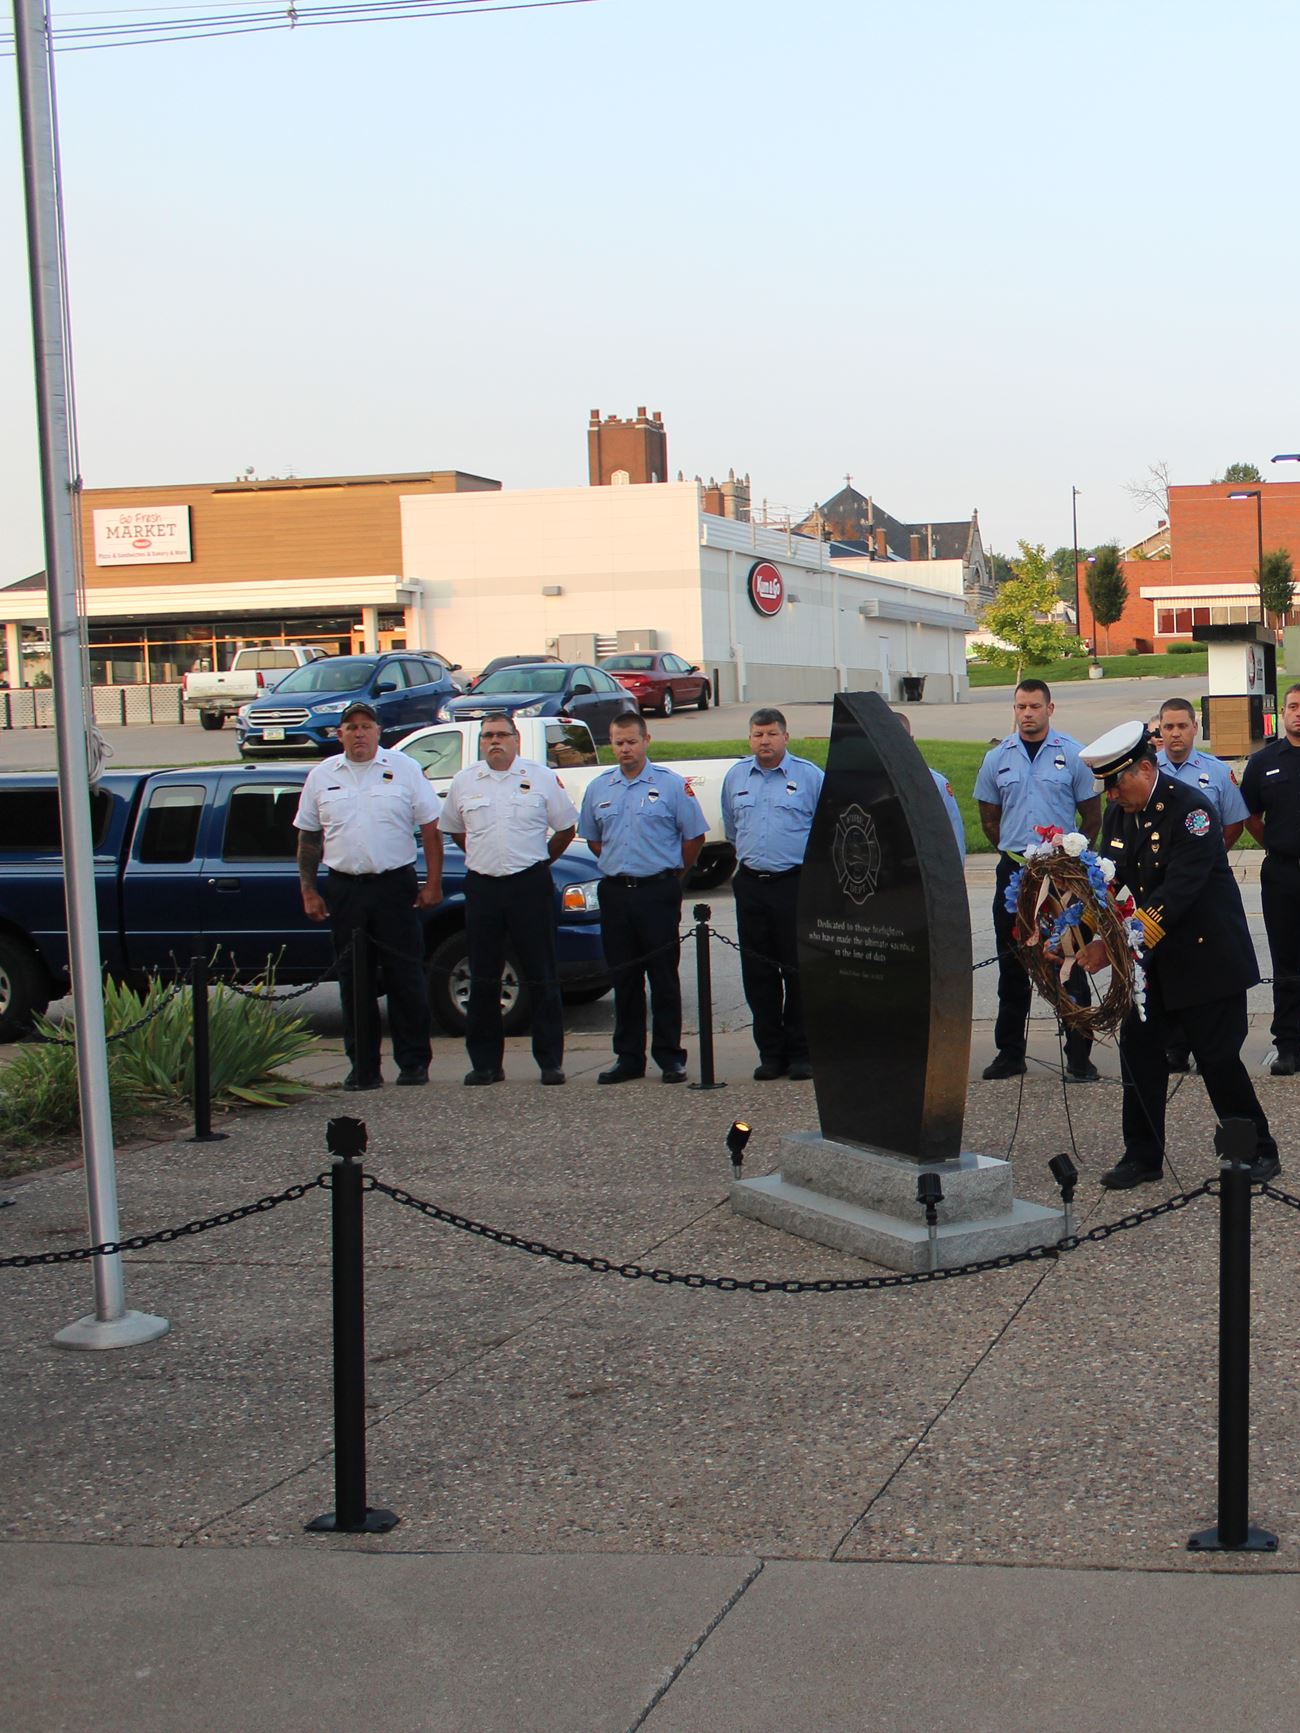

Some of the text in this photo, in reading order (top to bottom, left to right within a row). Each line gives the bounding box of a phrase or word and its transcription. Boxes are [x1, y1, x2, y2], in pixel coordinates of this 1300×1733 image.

[135, 512, 161, 523] Fresh
[106, 524, 176, 539] MARKET
[817, 919, 845, 931] Dedicated
[846, 922, 854, 931] to
[854, 923, 870, 934] those
[808, 932, 820, 940] who
[821, 932, 835, 943] have
[836, 935, 852, 945] made
[853, 936, 864, 946] the
[842, 948, 852, 958] the
[865, 951, 873, 960] of
